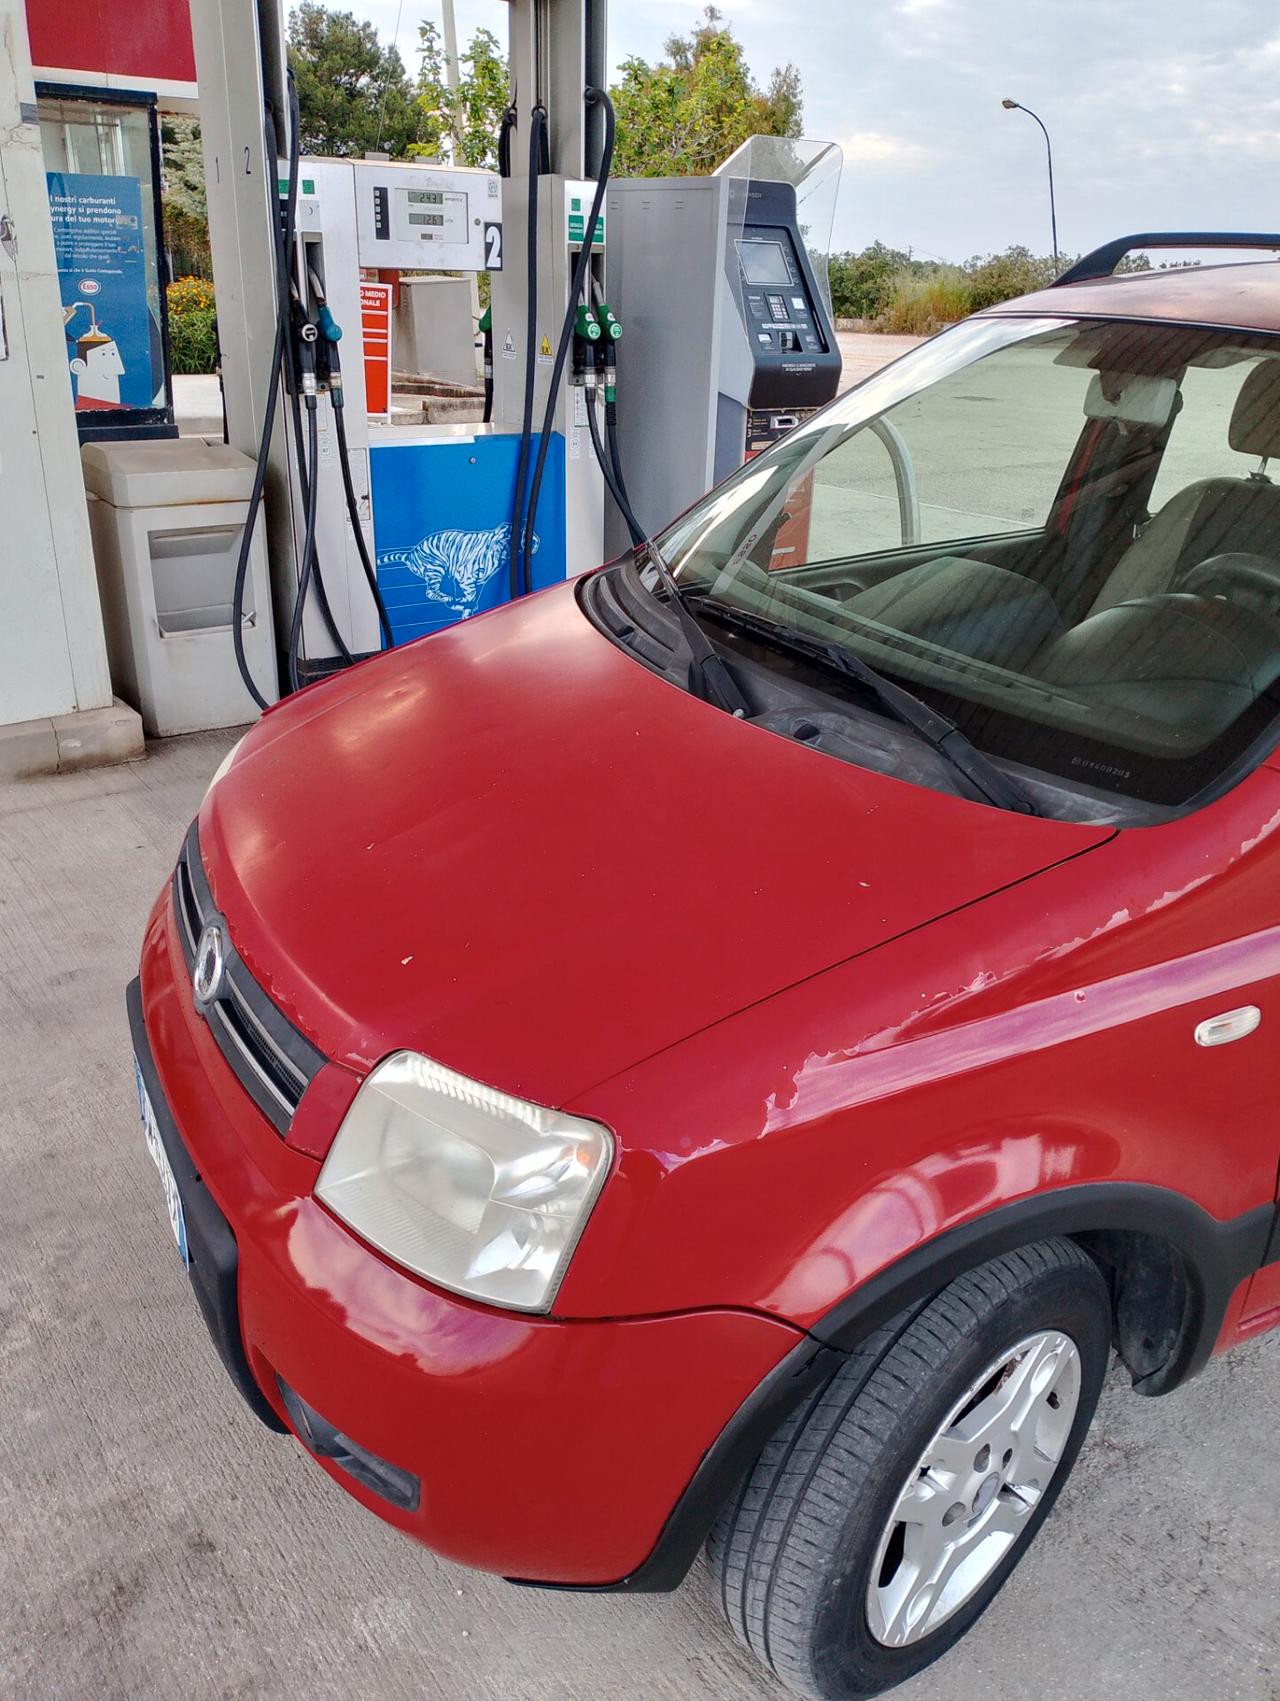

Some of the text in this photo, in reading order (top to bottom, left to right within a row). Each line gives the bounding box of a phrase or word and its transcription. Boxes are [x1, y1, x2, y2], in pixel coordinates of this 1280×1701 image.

[55, 195, 77, 203] nostri
[78, 196, 116, 205] carburanti
[50, 206, 76, 214] ynergy
[86, 207, 122, 215] prendono
[486, 226, 501, 268] 2
[365, 290, 387, 298] MEDIO
